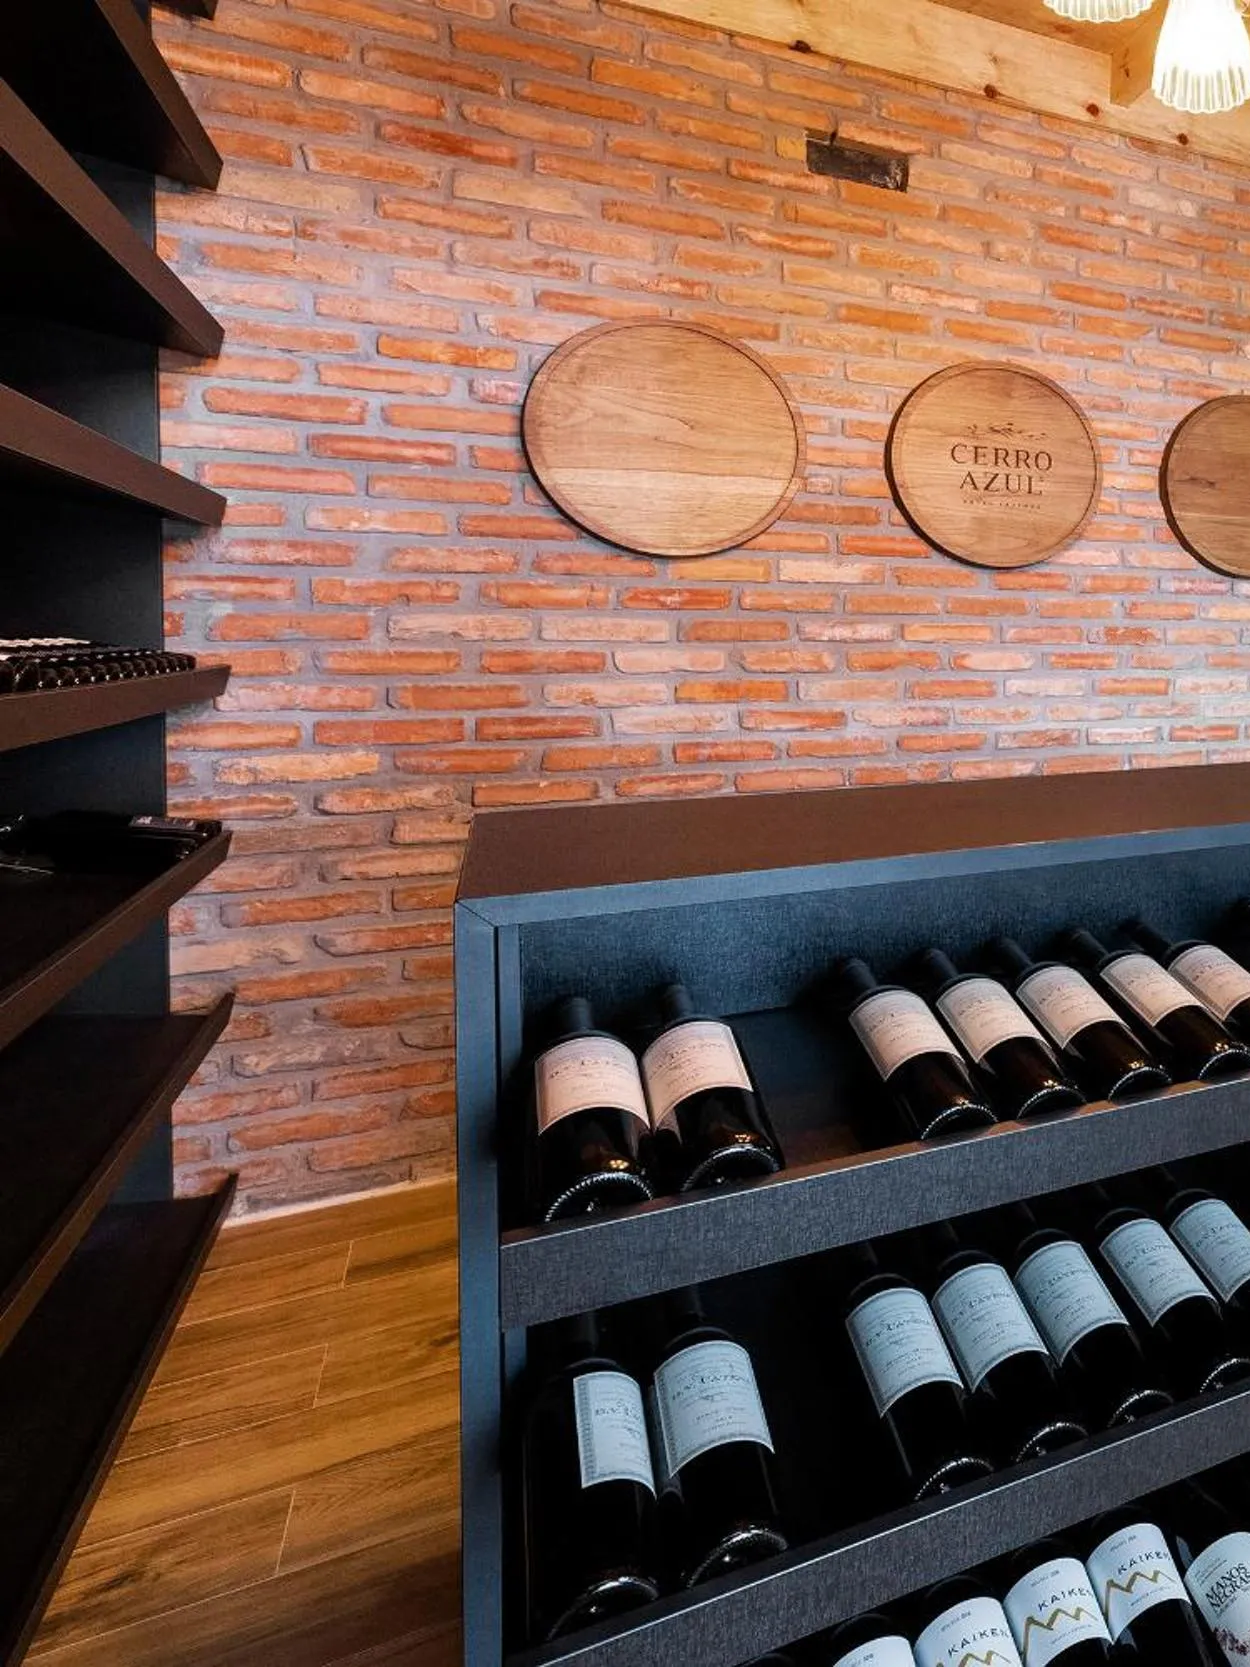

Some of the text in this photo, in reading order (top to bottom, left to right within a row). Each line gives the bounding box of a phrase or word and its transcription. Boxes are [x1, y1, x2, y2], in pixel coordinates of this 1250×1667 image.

[951, 443, 1053, 471] CERRO
[959, 471, 1043, 496] AZUL
[1205, 1563, 1247, 1601] MANOS
